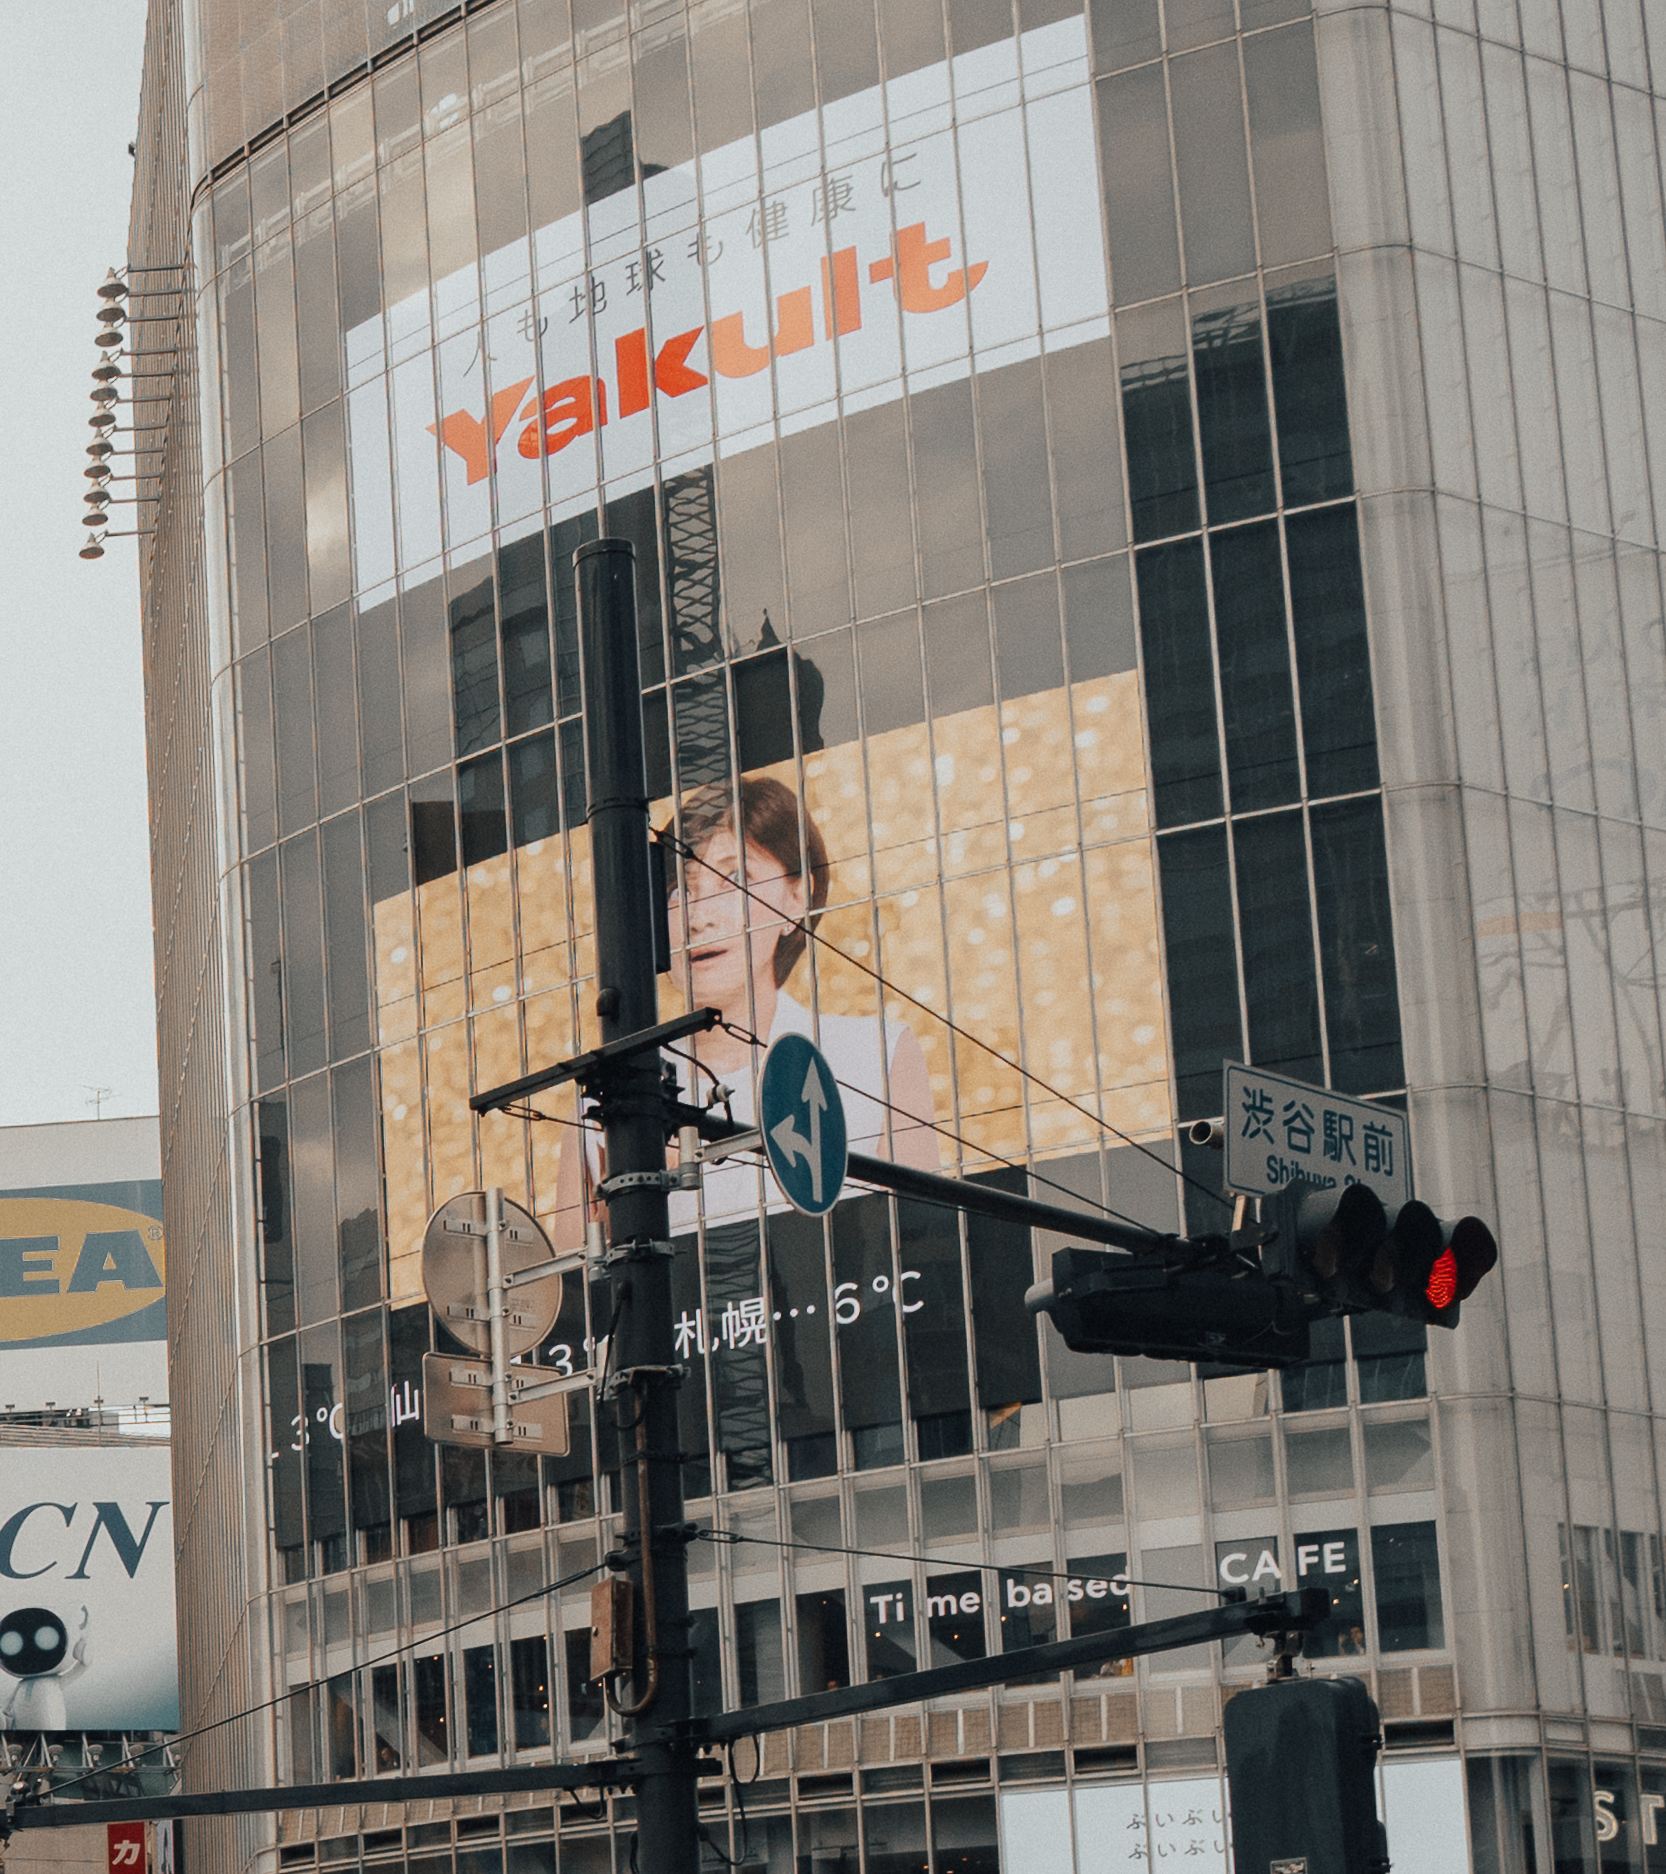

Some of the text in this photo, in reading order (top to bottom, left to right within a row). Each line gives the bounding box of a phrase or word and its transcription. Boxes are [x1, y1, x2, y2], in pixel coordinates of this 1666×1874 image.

[464, 152, 920, 378] 人も地球も健康に
[425, 221, 989, 486] Yakult
[1240, 1086, 1396, 1178] 渋谷駅前
[674, 1297, 768, 1359] 札幌
[872, 1542, 1346, 1624] Time based CAFE
